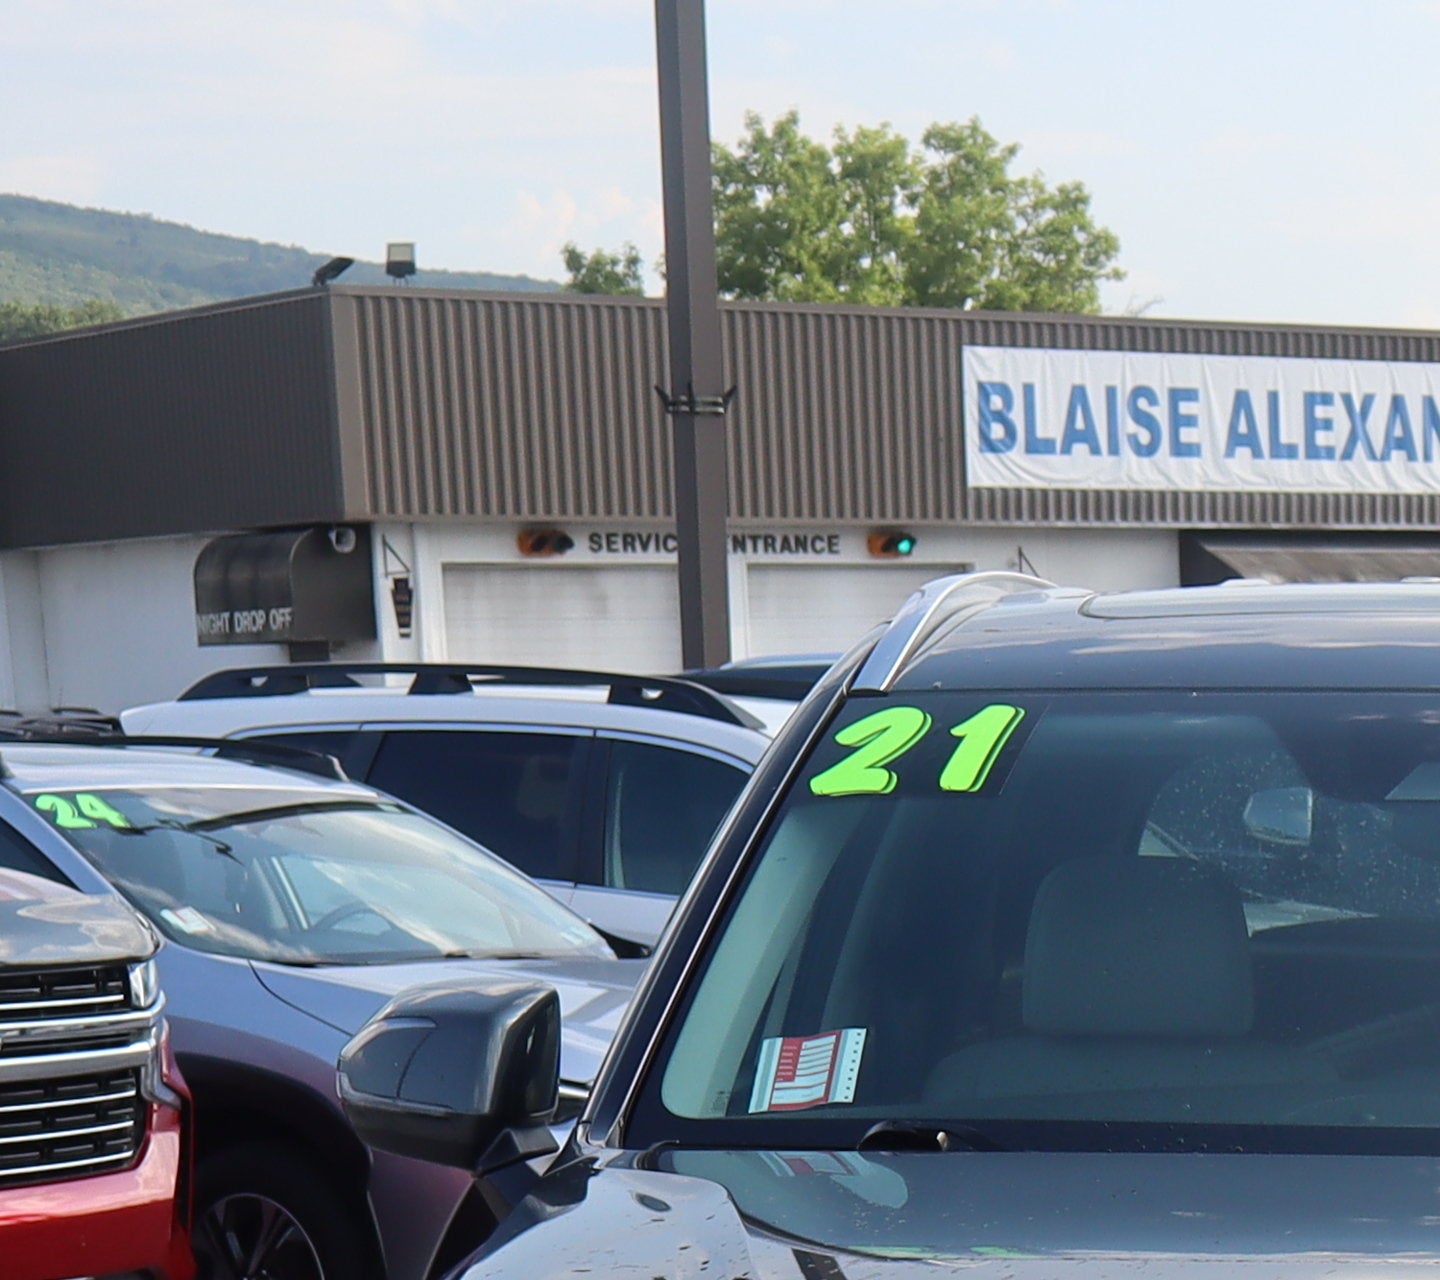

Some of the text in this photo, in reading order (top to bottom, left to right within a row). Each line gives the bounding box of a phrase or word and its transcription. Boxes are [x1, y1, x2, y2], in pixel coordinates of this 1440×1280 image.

[977, 380, 1203, 459] BLAISE
[588, 531, 841, 555] SERVIC NTRANCE
[233, 608, 266, 634] DROP
[268, 606, 292, 631] OFF
[809, 702, 1027, 797] 21
[35, 793, 132, 829] 24
